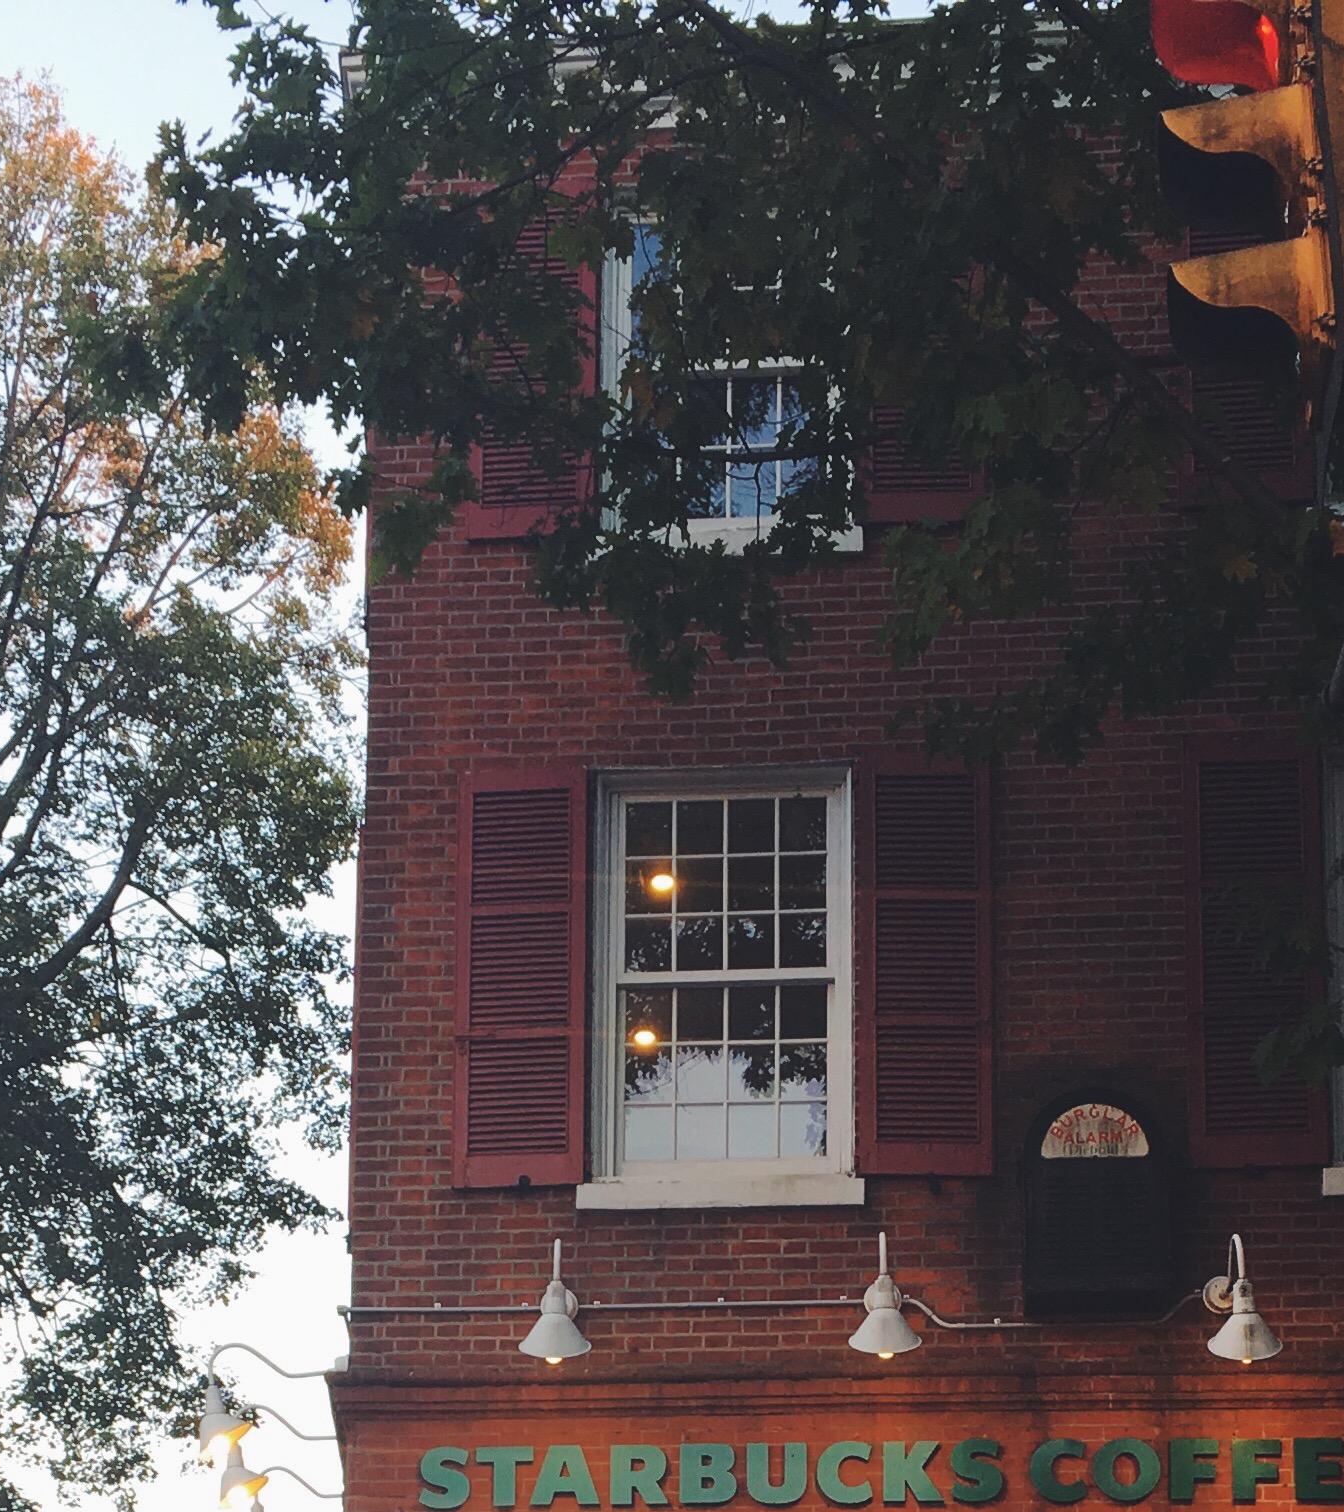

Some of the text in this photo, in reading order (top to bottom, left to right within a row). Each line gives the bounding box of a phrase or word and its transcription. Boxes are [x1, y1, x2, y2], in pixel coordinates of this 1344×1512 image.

[1049, 1104, 1140, 1139] BURGLAR
[1063, 1131, 1123, 1144] ALARM
[419, 1438, 1005, 1509] STARBUCKS
